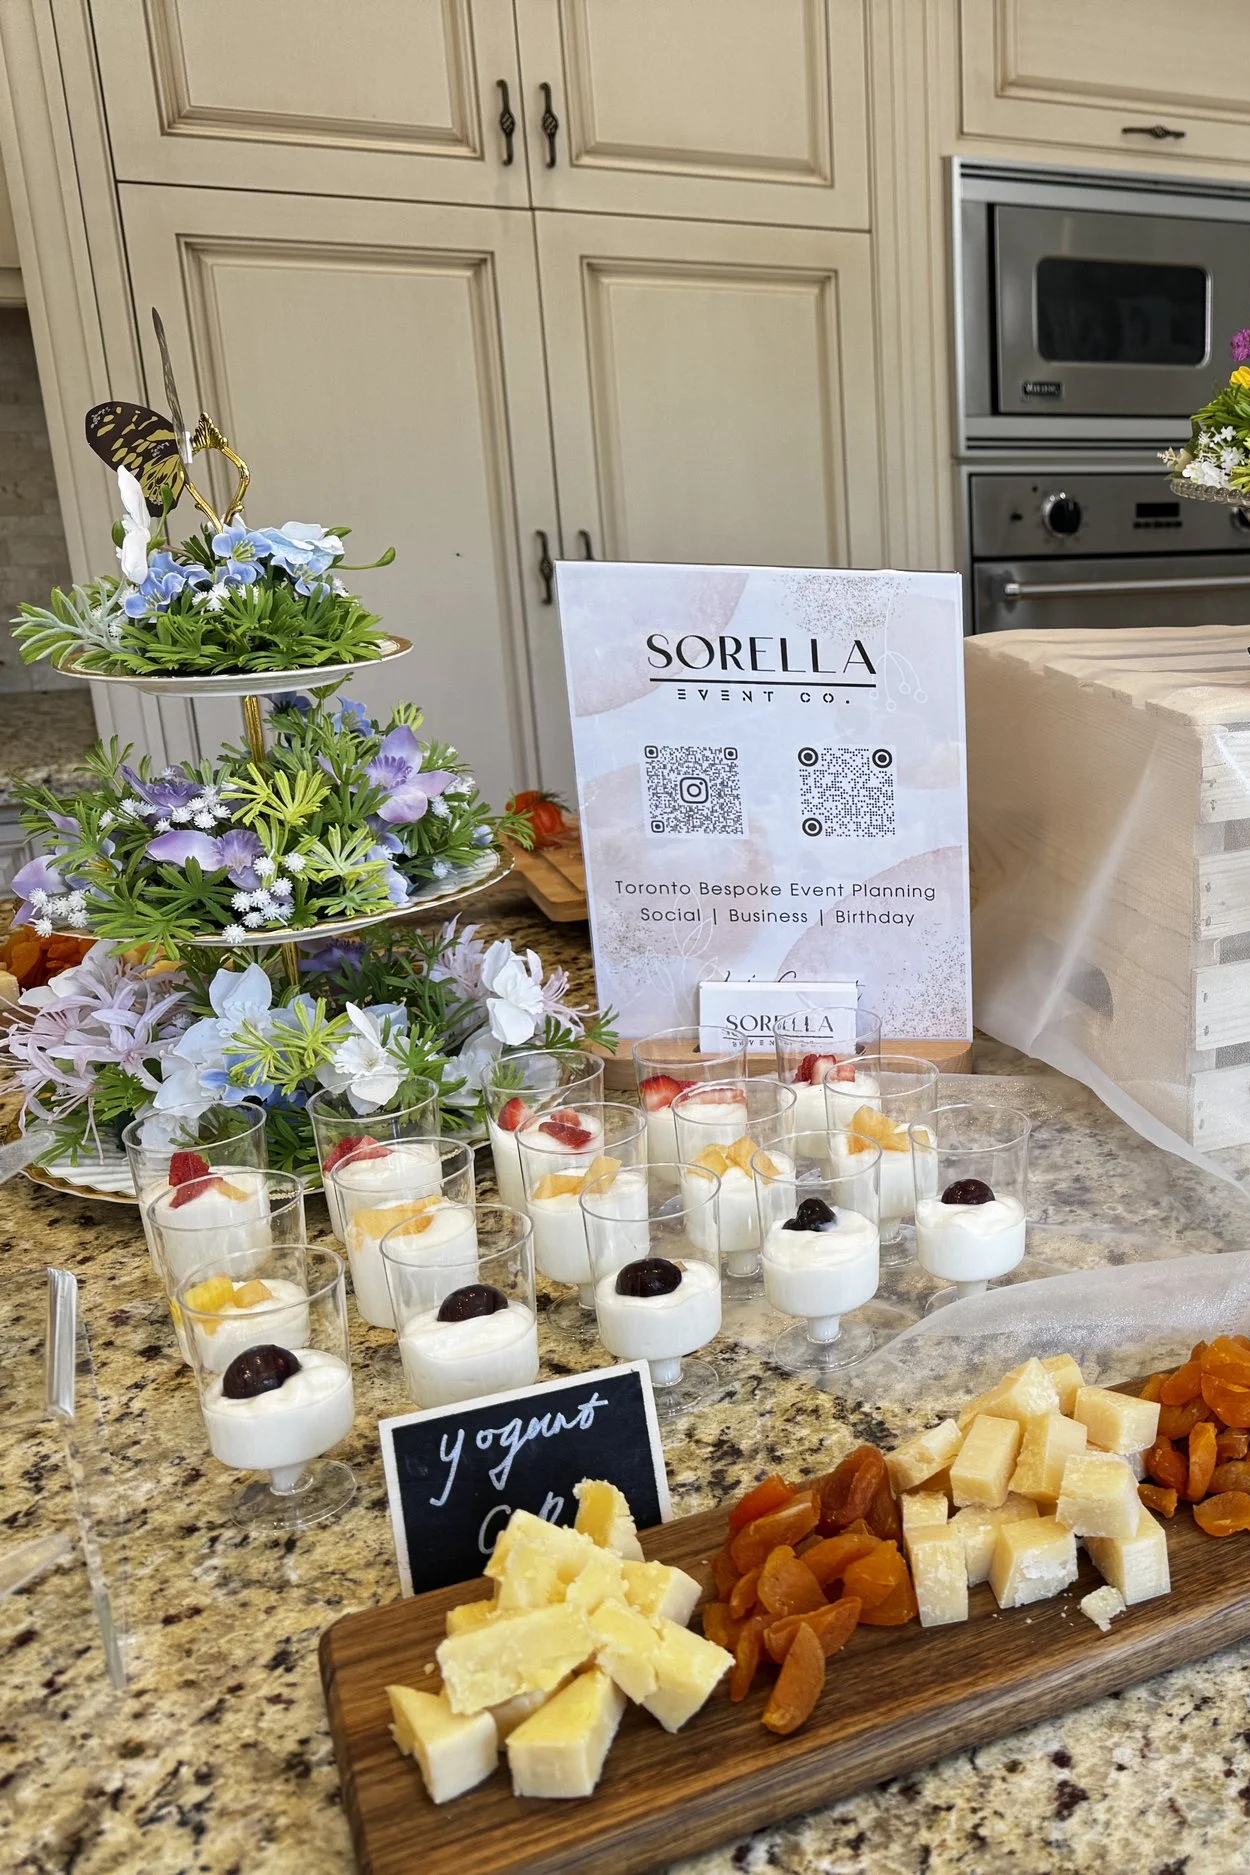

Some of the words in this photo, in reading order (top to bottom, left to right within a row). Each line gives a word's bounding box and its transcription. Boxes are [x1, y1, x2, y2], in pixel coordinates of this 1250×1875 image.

[646, 633, 877, 674] SORELLA
[677, 688, 774, 703] EVENT
[799, 691, 851, 705] CO.
[615, 880, 691, 895] Toronto
[699, 882, 782, 898] Bespoke
[790, 883, 844, 897] Event
[852, 884, 935, 901] Planning
[640, 908, 701, 922] Social
[729, 909, 808, 923] Business
[836, 910, 915, 927] Birthday
